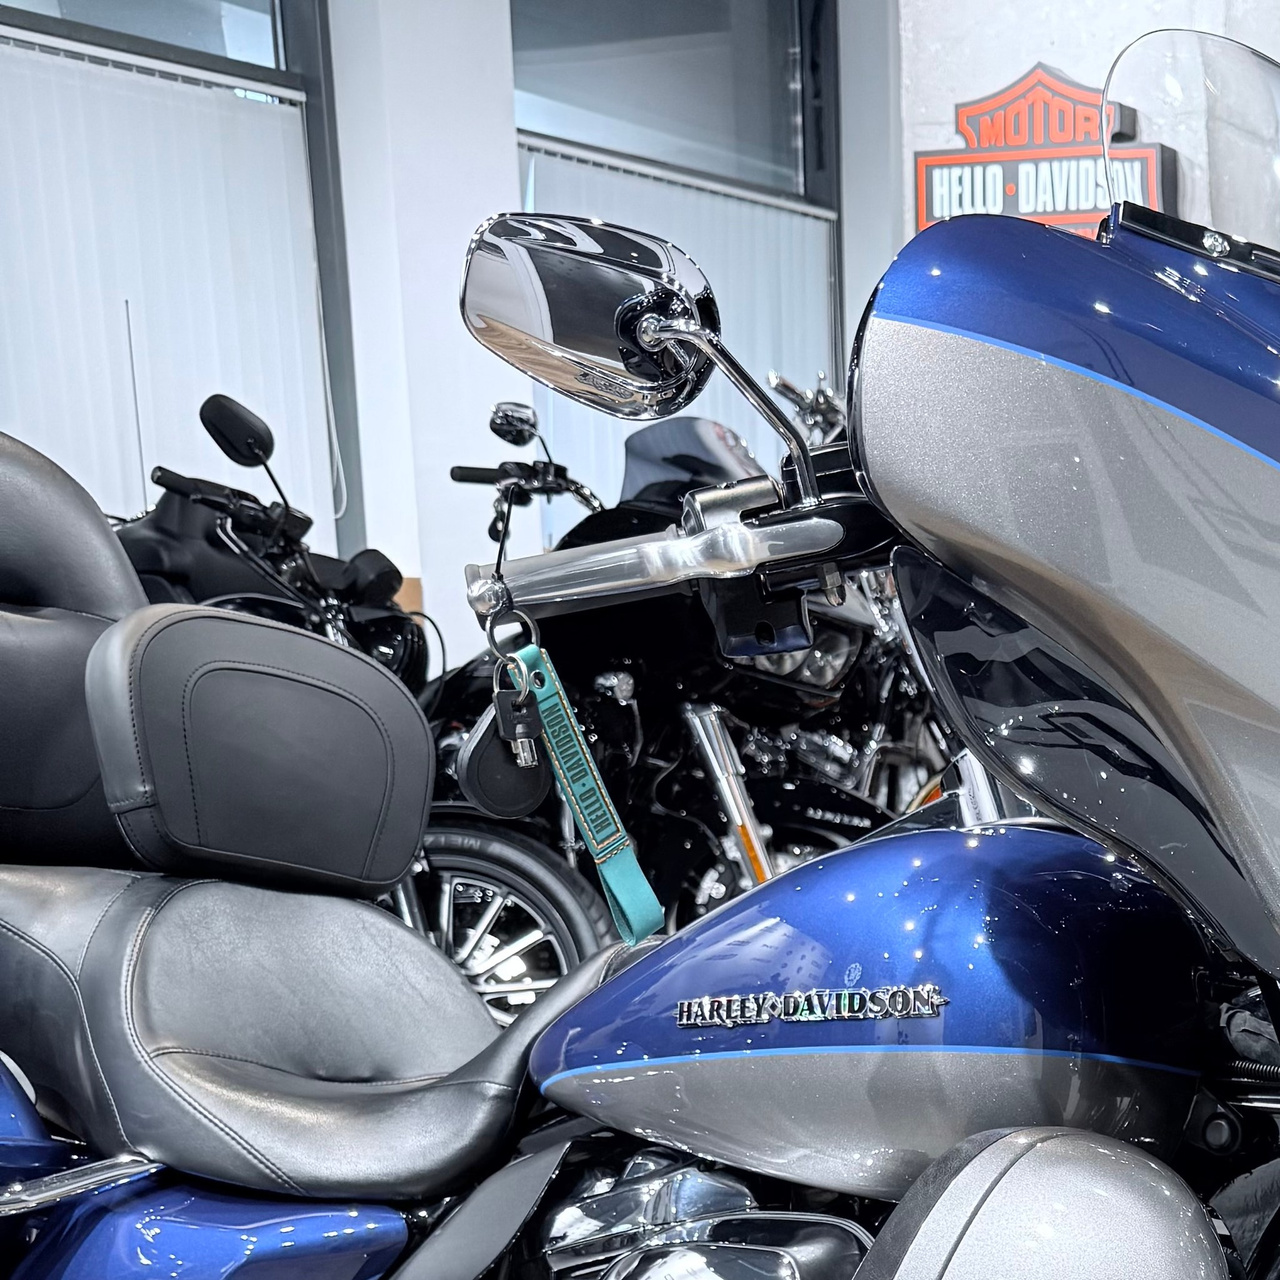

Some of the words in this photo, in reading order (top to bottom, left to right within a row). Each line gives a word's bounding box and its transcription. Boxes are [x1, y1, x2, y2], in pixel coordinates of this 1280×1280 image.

[978, 86, 1101, 148] MOTOR
[931, 164, 1004, 218] HELLO
[541, 702, 589, 785] DAVIDSON
[579, 787, 612, 834] HELLO
